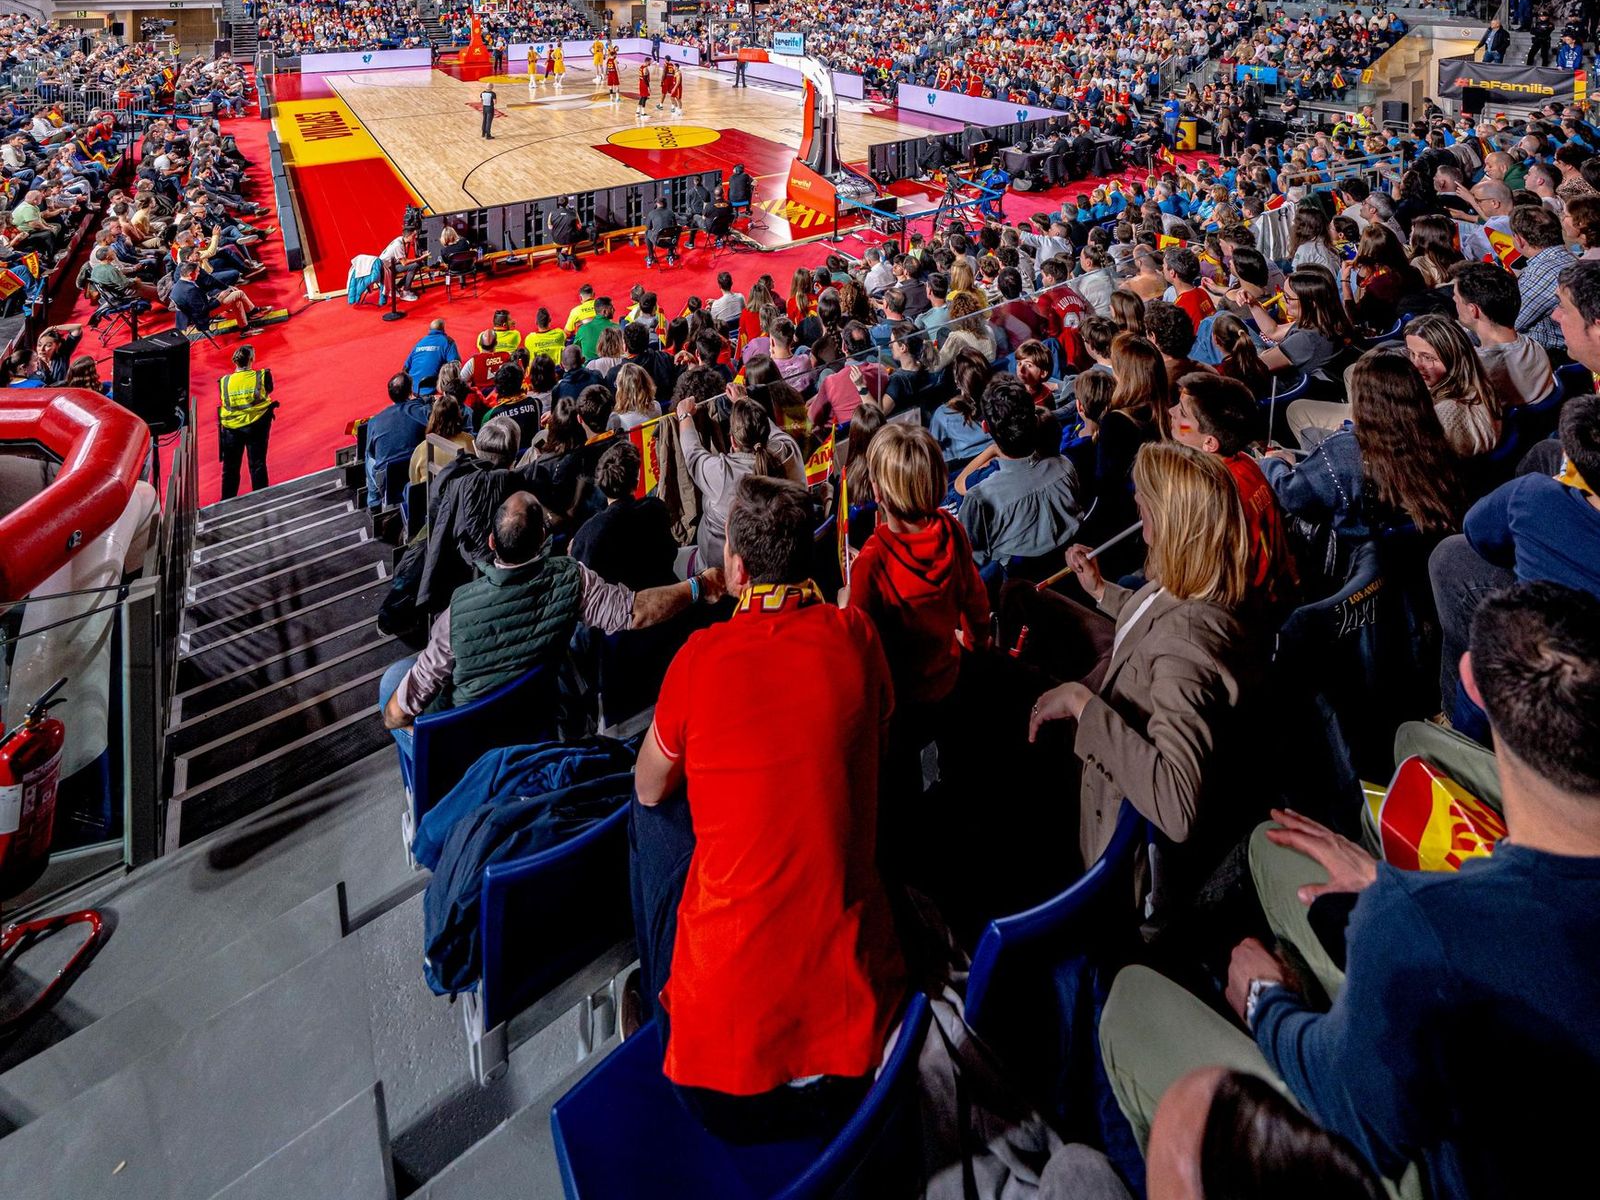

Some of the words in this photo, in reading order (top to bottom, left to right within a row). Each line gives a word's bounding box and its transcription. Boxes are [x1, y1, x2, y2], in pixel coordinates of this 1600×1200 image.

[1454, 76, 1555, 96] #LaFamilia
[295, 110, 360, 142] ESPAÑA
[654, 126, 678, 148] endesa
[486, 357, 503, 366] GASOL
[519, 404, 535, 414] SUR
[1348, 591, 1364, 605] LOS
